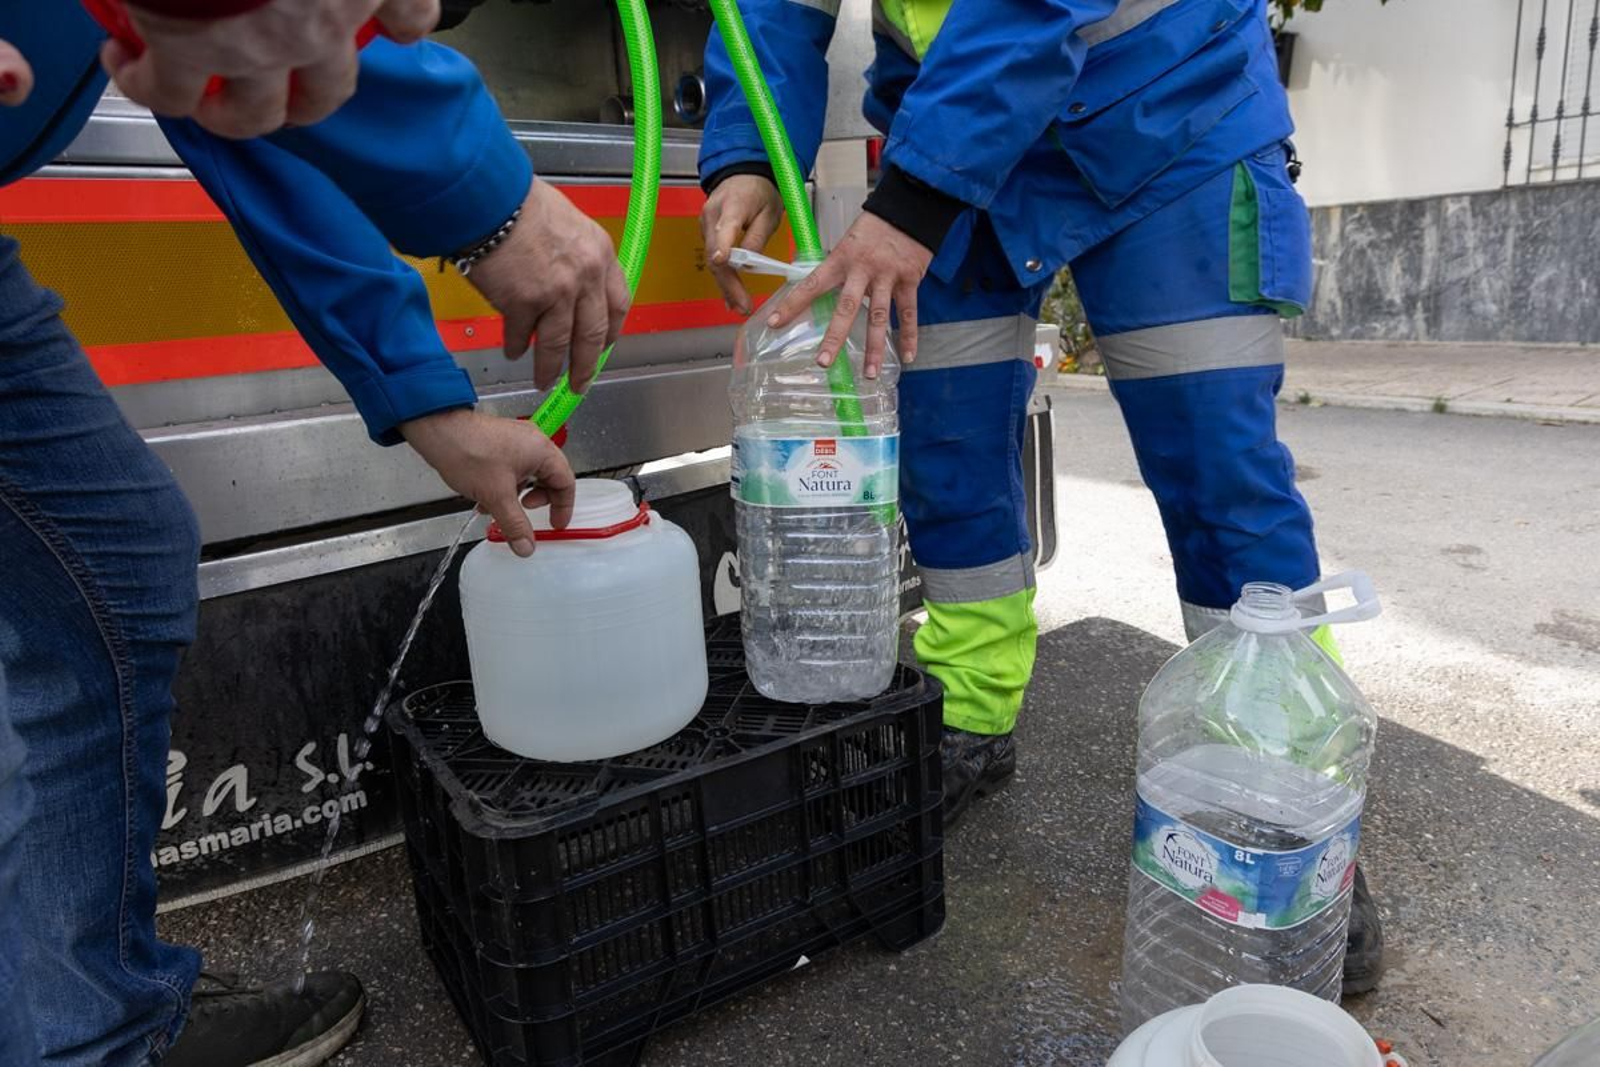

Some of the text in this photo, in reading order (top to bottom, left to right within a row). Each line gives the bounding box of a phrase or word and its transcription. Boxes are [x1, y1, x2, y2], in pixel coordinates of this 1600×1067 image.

[811, 470, 839, 479] FONT
[799, 477, 852, 492] Natura
[1163, 844, 1213, 884] Natura
[1177, 846, 1206, 867] FONT
[1234, 850, 1256, 865] 8L
